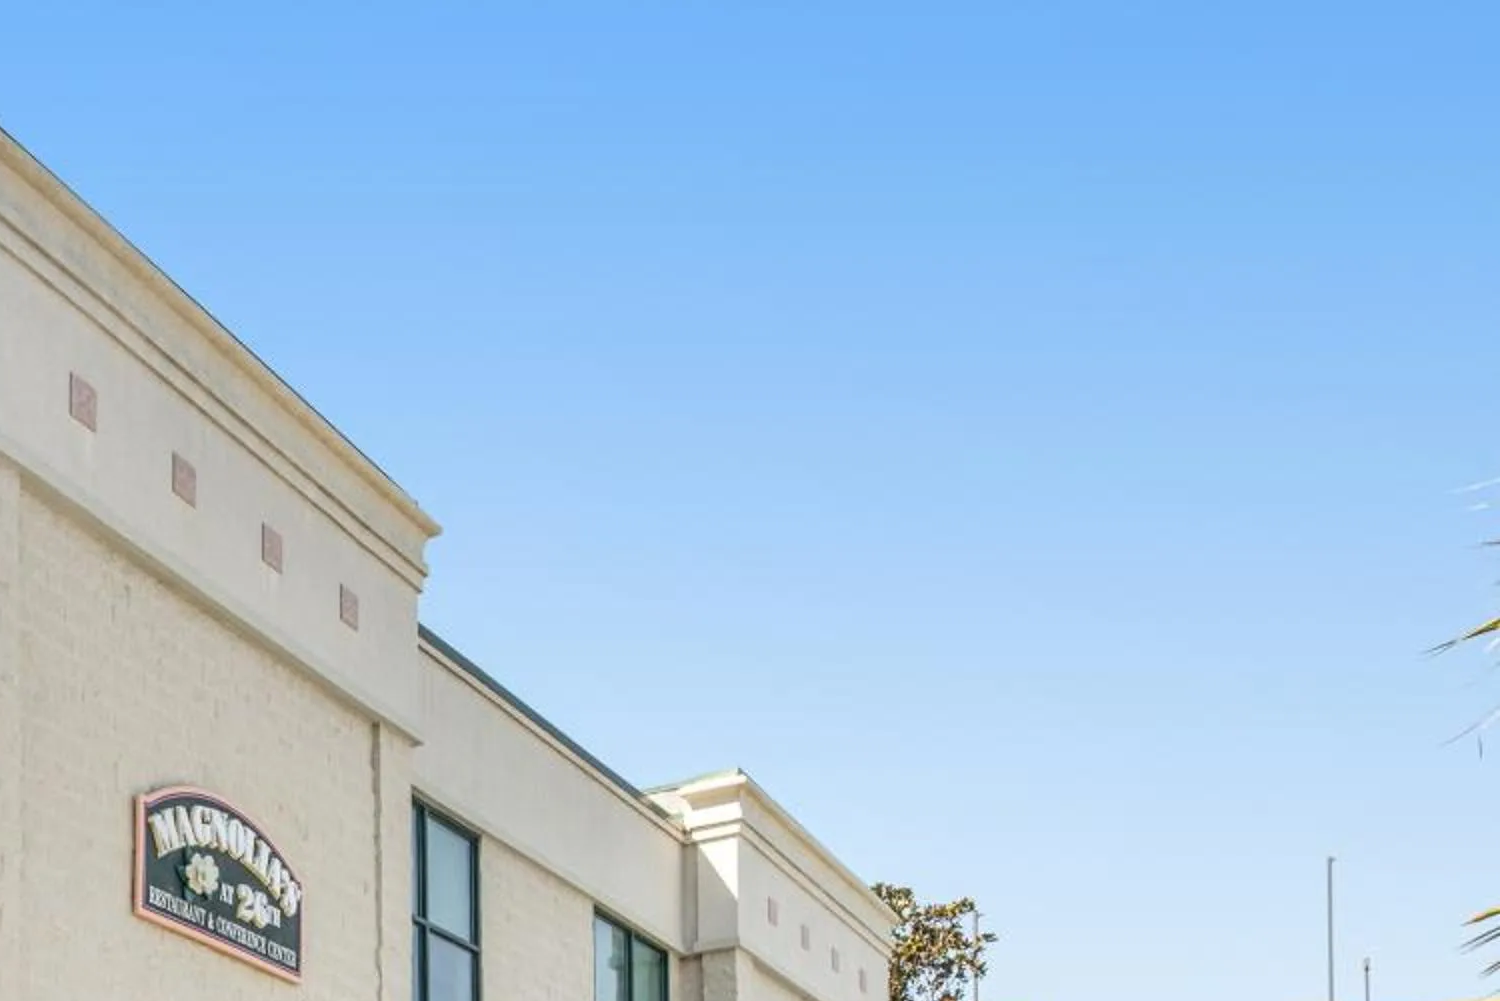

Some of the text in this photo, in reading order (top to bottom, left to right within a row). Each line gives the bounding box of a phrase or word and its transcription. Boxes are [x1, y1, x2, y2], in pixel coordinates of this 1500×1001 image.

[219, 883, 235, 906] AT
[149, 885, 298, 968] RESTAURANT & CONFERENCE CENTER
